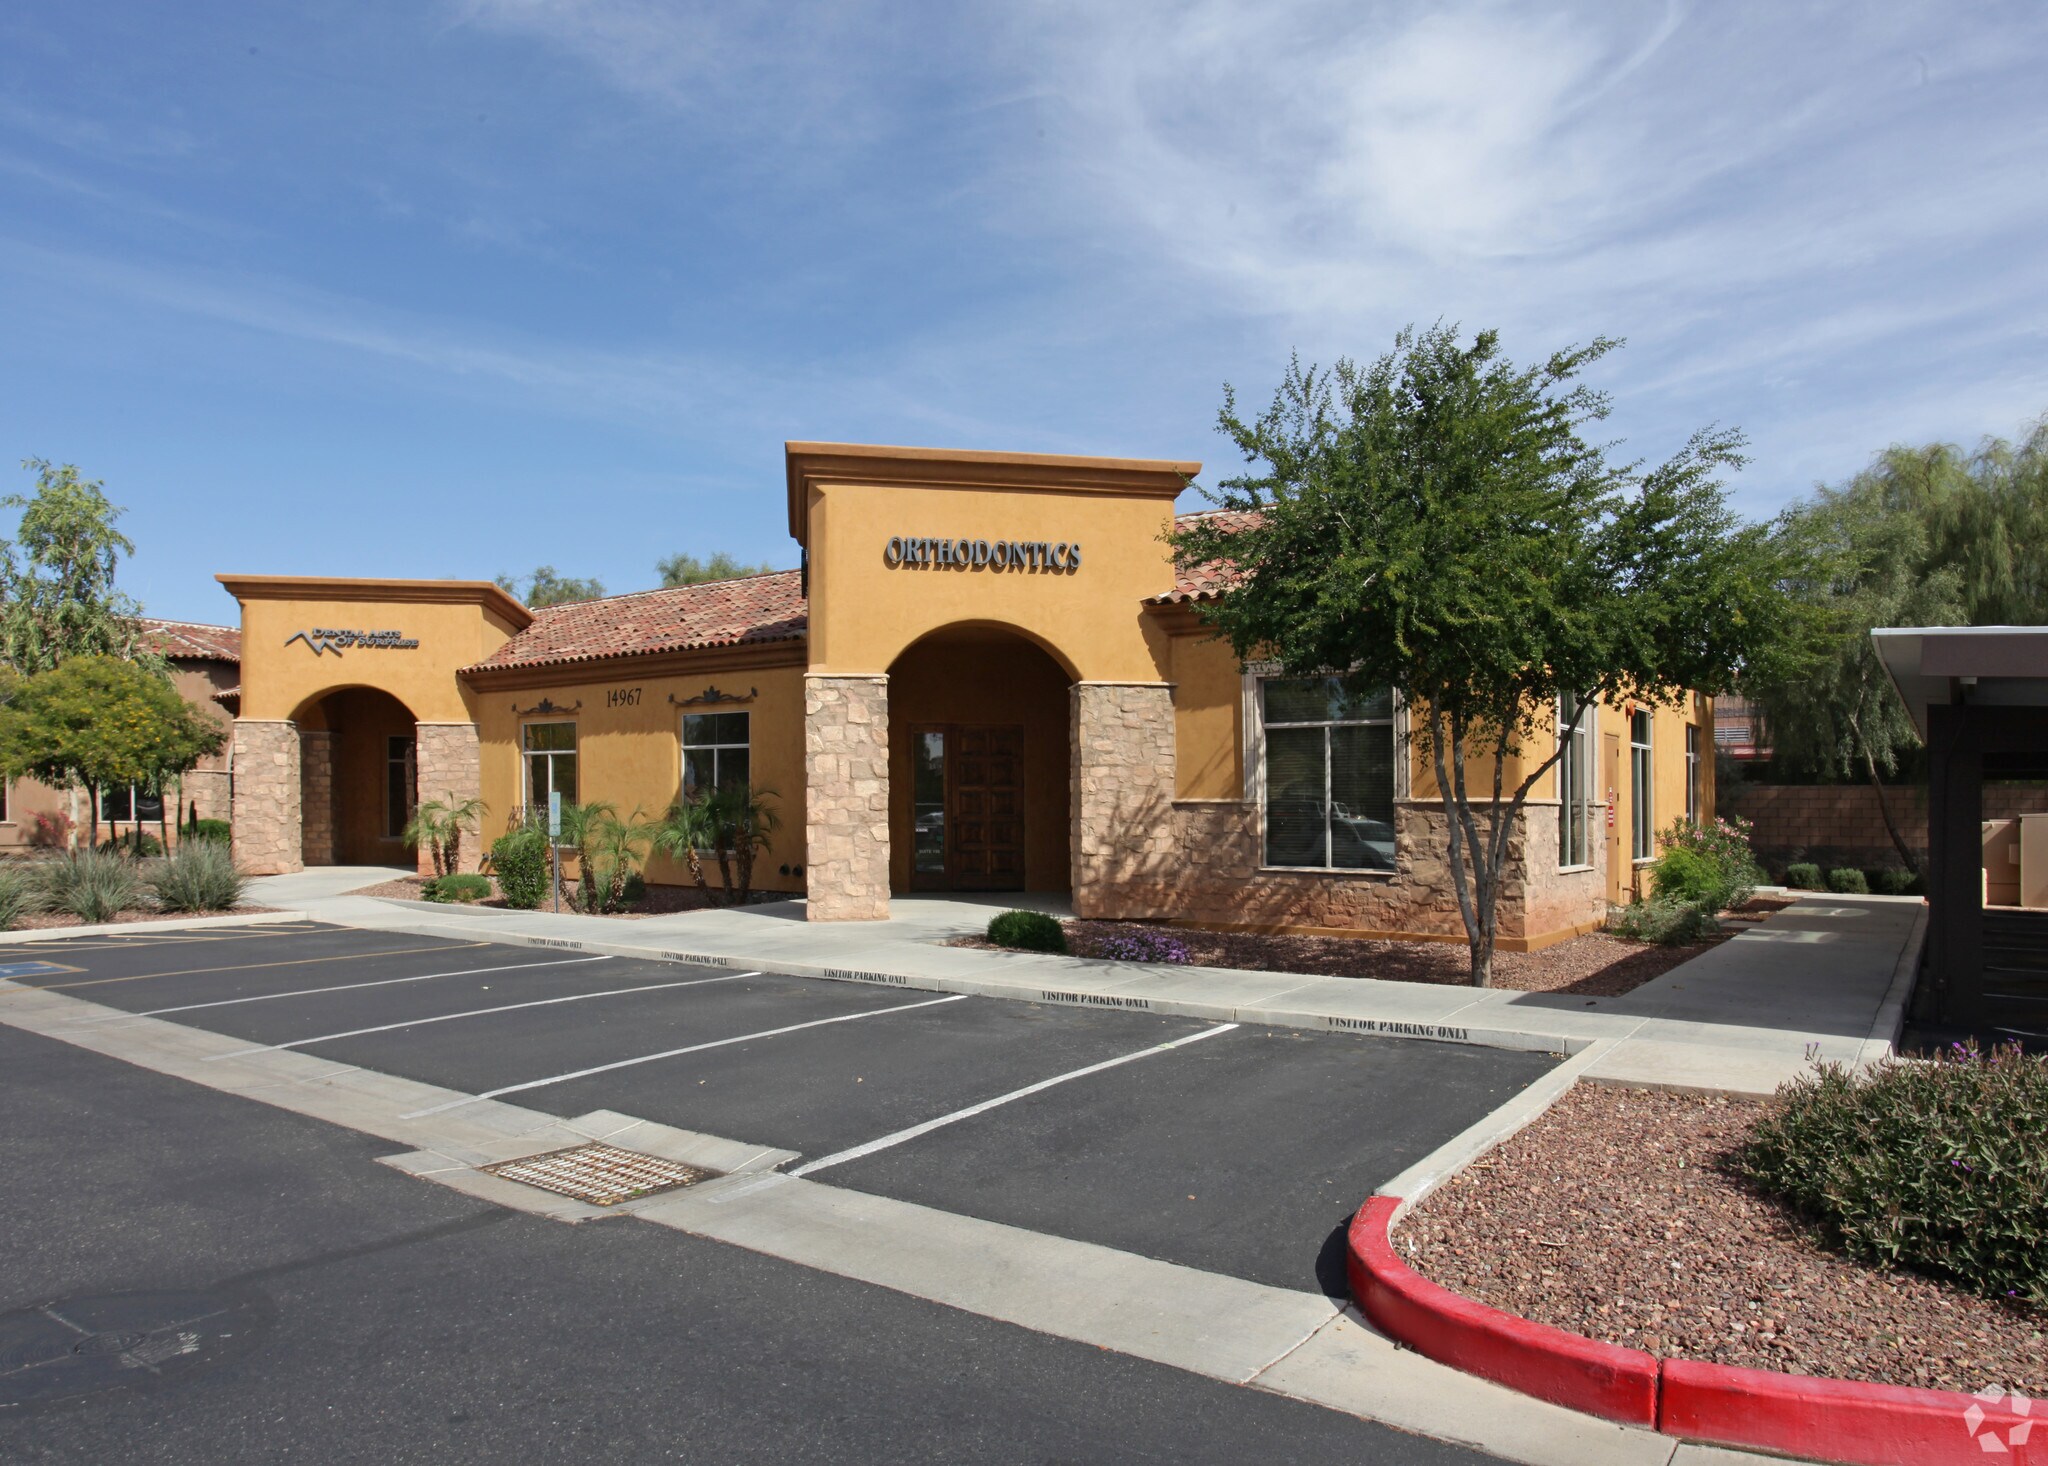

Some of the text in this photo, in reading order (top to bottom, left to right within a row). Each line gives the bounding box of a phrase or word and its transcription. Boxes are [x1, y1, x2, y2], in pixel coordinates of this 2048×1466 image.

[885, 536, 1082, 570] ORTHODONTICS
[312, 628, 401, 639] DENTAL ARTS
[335, 636, 419, 647] OF SURPRISE
[607, 688, 642, 708] 14967
[547, 939, 569, 948] PARKING
[661, 951, 727, 966] VISITOR PARKING ONLY
[824, 968, 908, 984] VISITOR PARKING ONLY
[1042, 990, 1149, 1009] VISITOR PARKING ONLY
[1328, 1017, 1469, 1040] VISITOR PARKING ONLY
